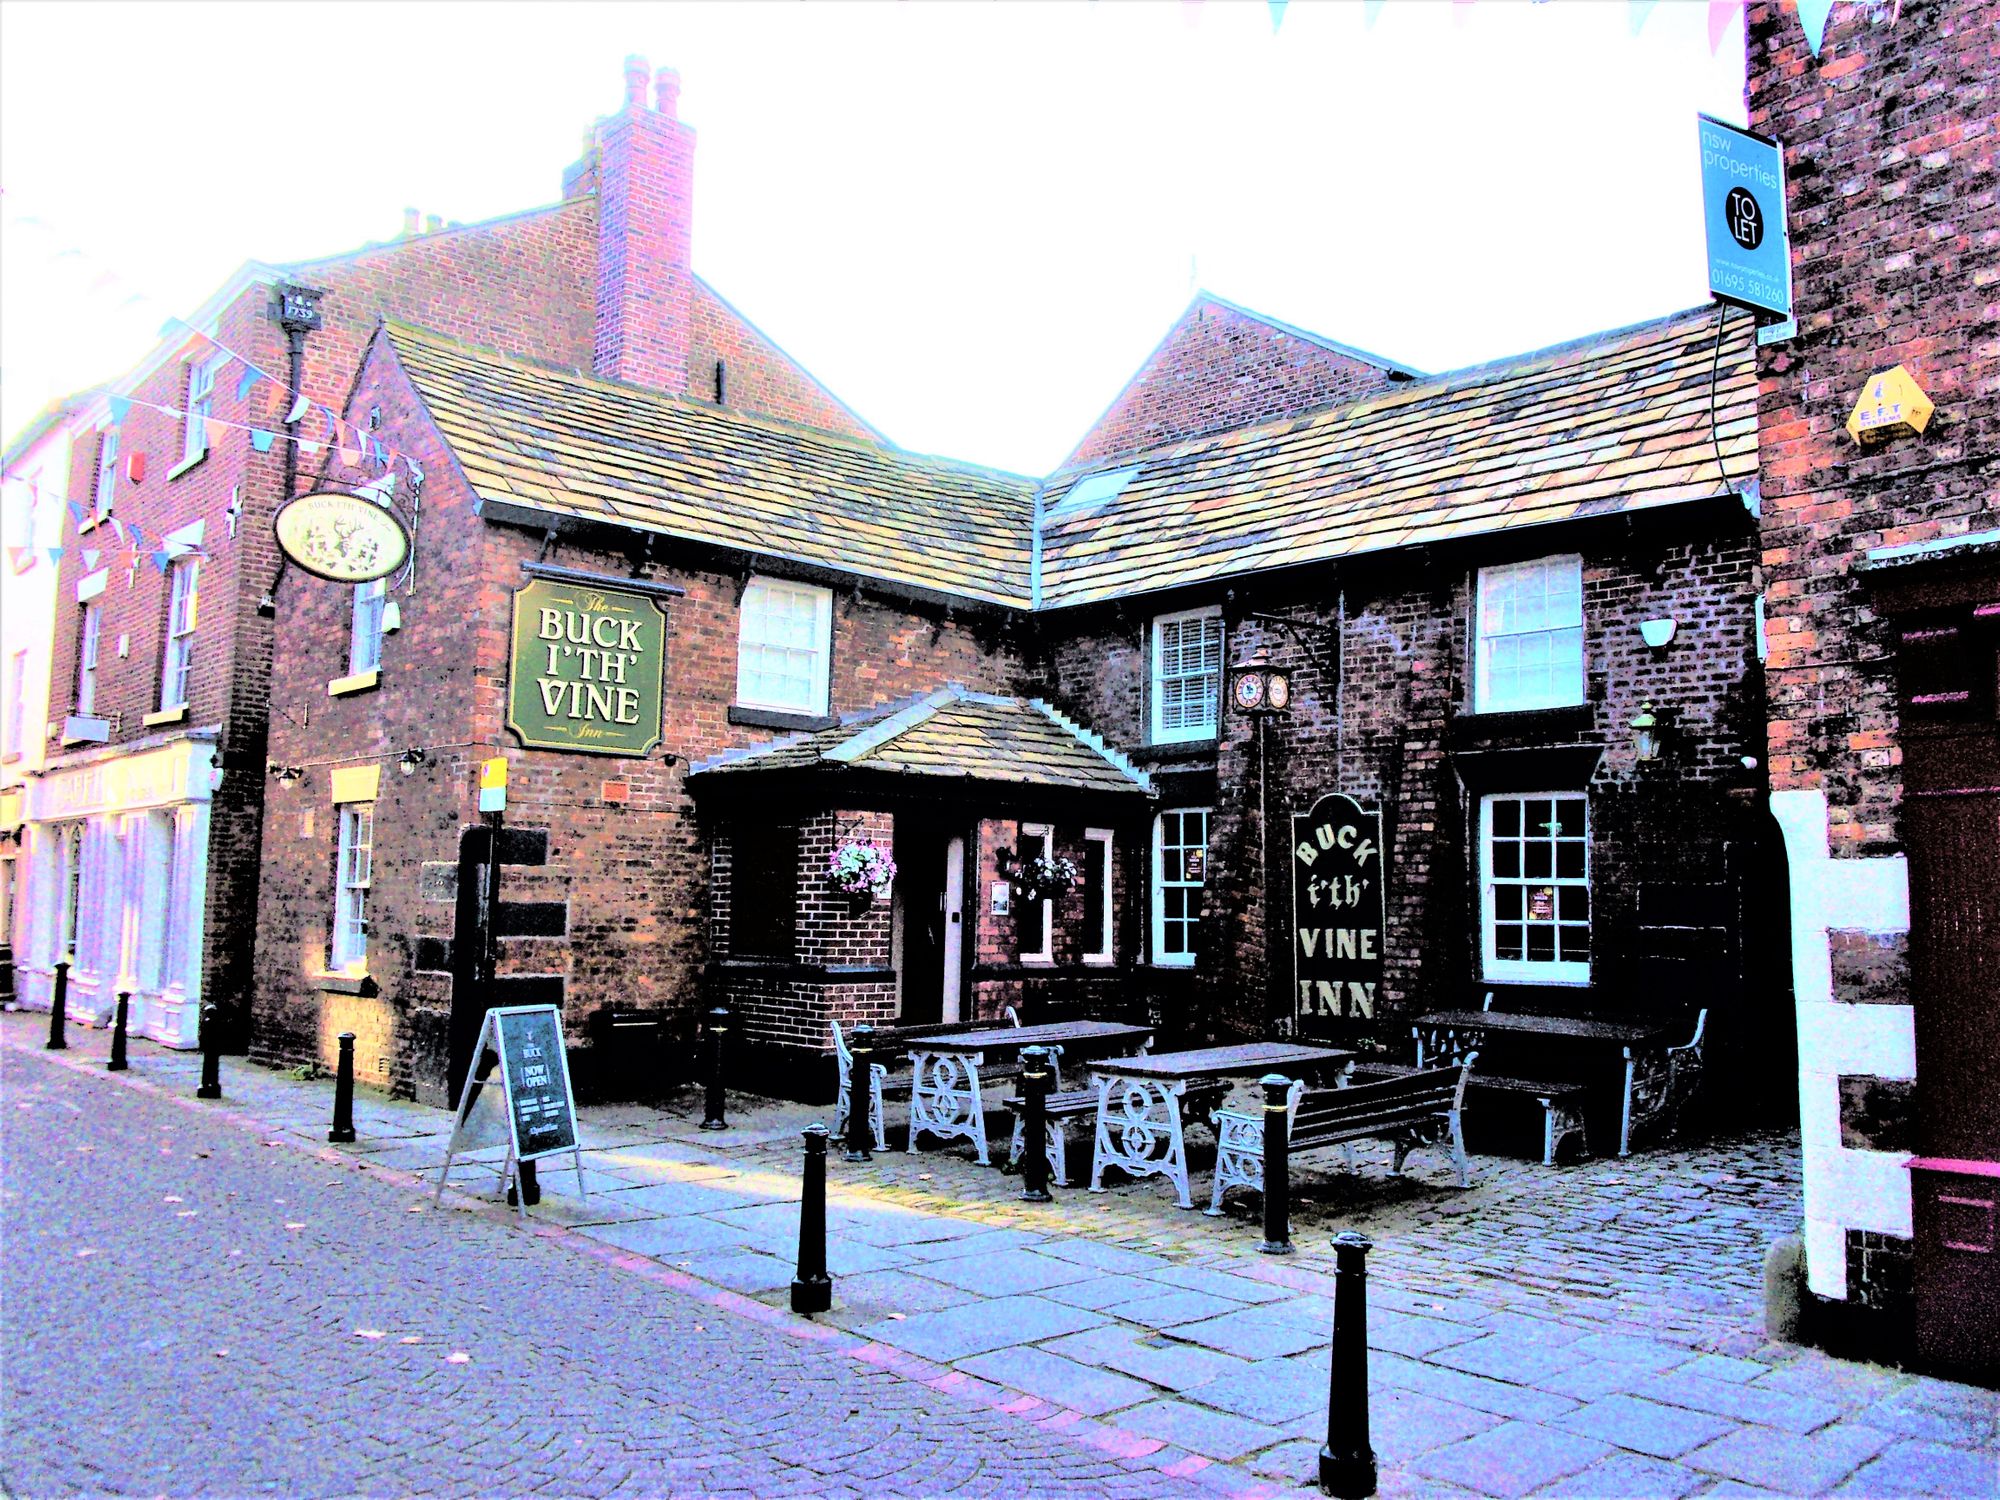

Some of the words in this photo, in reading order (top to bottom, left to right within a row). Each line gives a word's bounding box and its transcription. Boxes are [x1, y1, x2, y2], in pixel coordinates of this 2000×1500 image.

[1702, 131, 1731, 152] nsw
[1704, 149, 1777, 189] properties
[1732, 193, 1755, 220] TO
[1734, 216, 1757, 244] LET
[1712, 268, 1745, 291] 01695
[1748, 280, 1784, 304] 581260
[574, 592, 608, 613] The
[538, 607, 644, 652] BUCK
[546, 644, 638, 684] I'TH'
[537, 678, 640, 725] VINE
[569, 721, 603, 739] Inn
[1296, 823, 1378, 867] BUCK
[1299, 928, 1377, 960] VINE
[1299, 979, 1376, 1019] INN
[524, 1064, 545, 1077] NOW
[525, 1075, 548, 1088] OPEN
